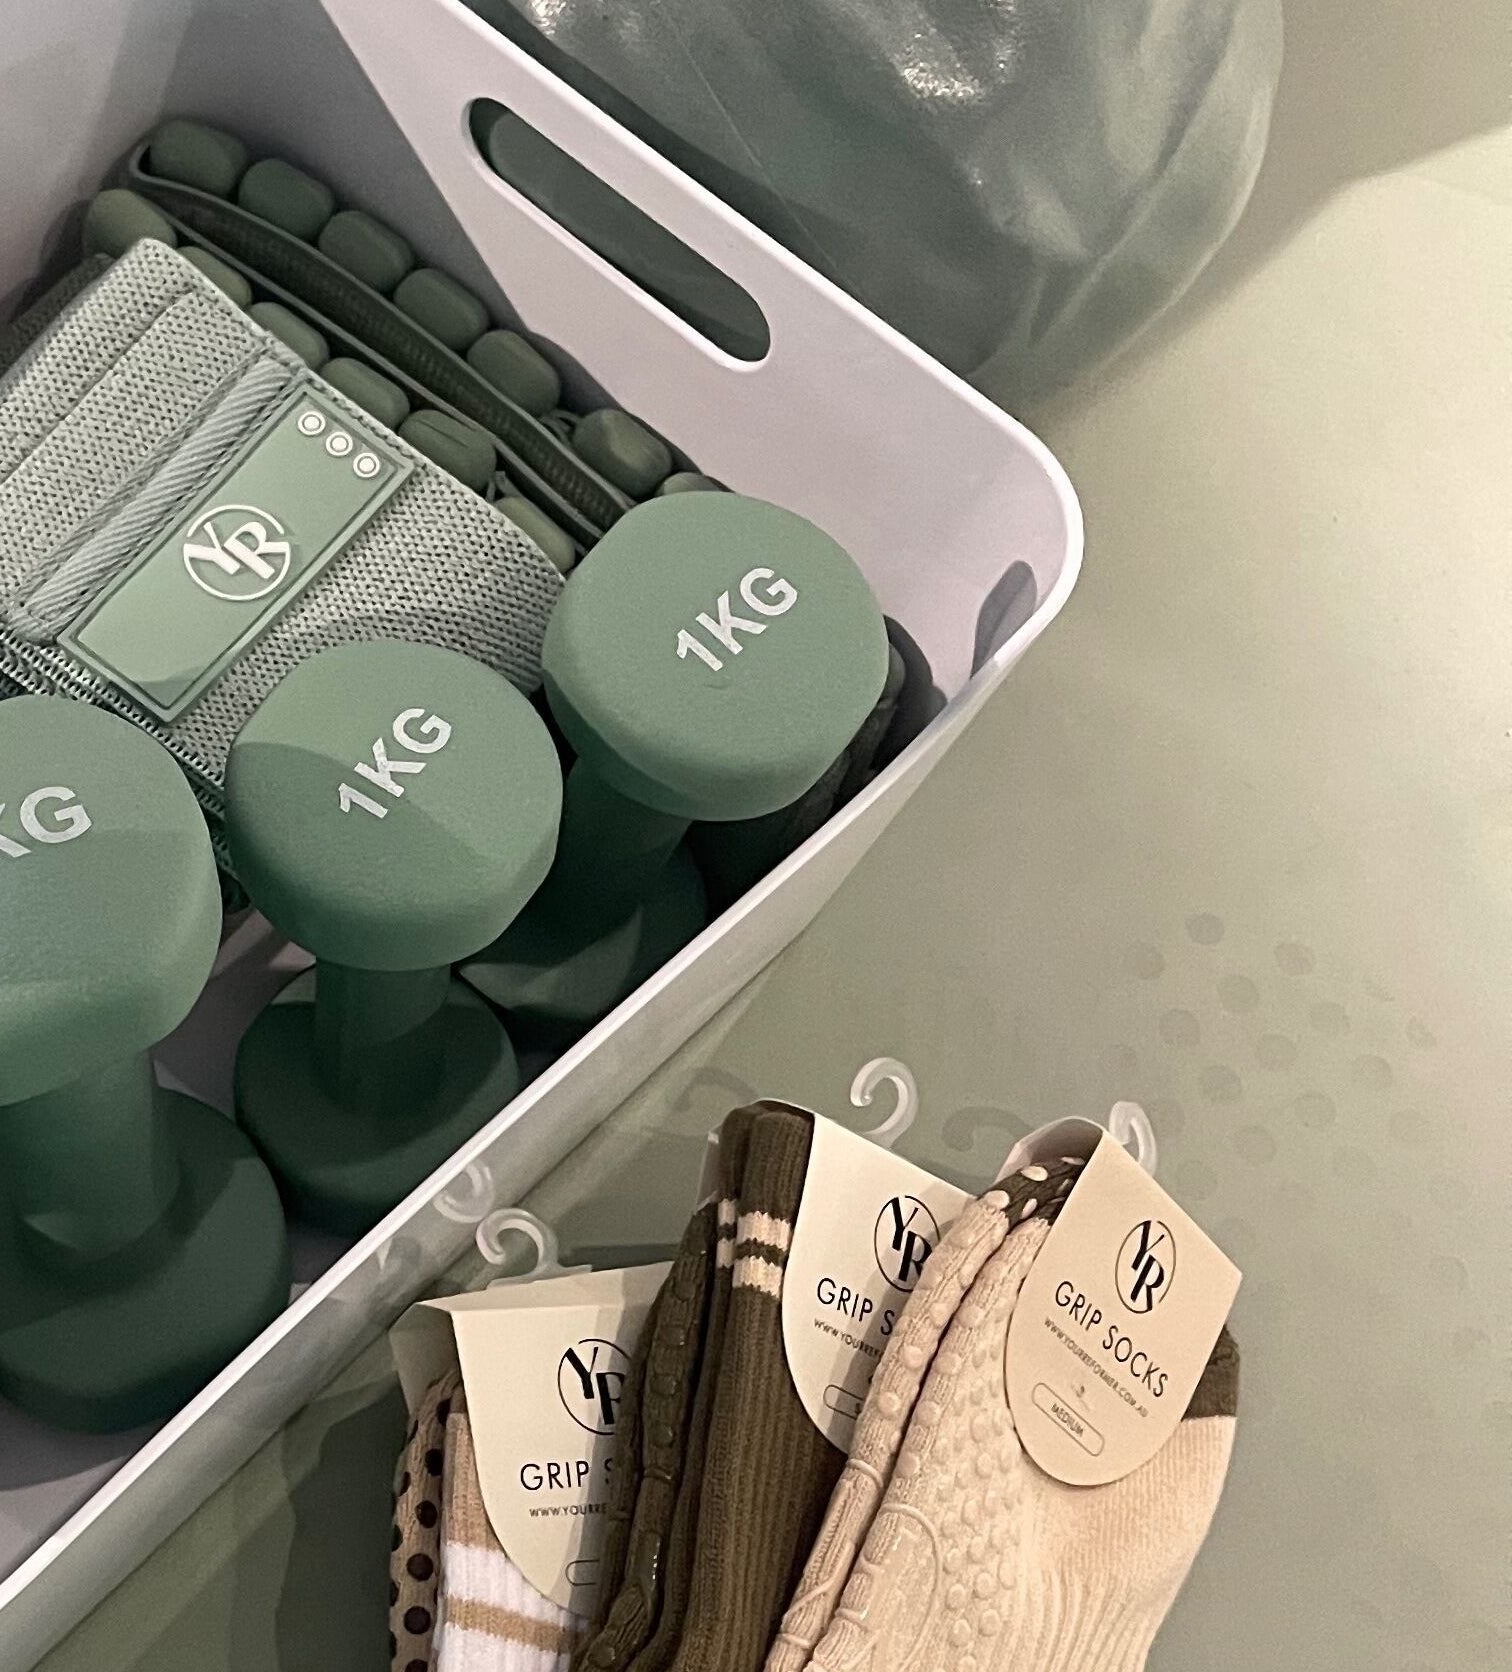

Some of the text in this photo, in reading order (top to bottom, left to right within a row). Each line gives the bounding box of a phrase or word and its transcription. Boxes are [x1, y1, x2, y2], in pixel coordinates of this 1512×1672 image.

[184, 521, 289, 580] YR
[676, 566, 800, 673] 1KG
[338, 707, 453, 820] 1KG
[890, 1196, 933, 1282] YR
[1130, 1219, 1166, 1312] YR
[817, 1277, 873, 1322] GRIP
[1054, 1280, 1169, 1398] GRIP SOCKS
[1051, 1401, 1085, 1438] MEDIUM
[519, 1460, 589, 1491] GRIP
